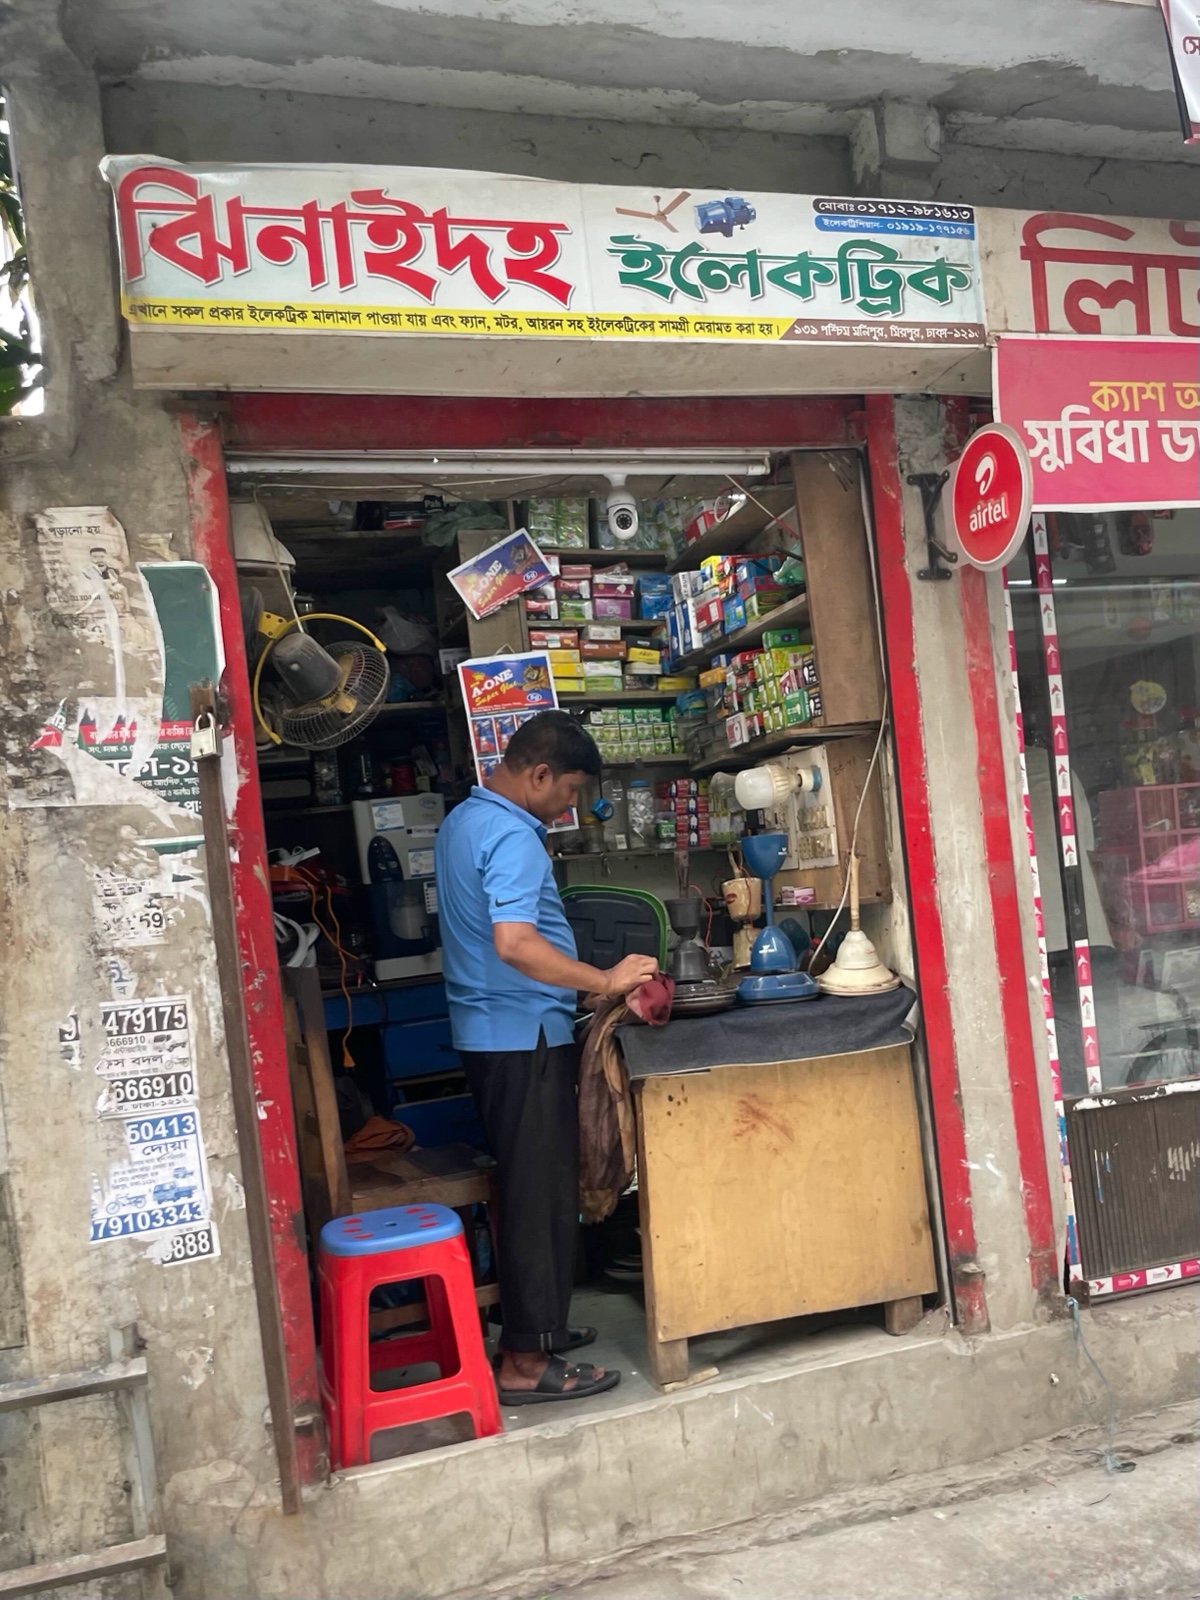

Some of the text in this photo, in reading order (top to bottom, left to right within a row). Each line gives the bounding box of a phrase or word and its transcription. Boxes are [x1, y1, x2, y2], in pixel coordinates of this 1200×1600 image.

[118, 166, 572, 308] ঝিনাইদহ
[605, 234, 973, 318] ইলেকট্রিক
[129, 303, 167, 318] এখানে
[171, 305, 204, 320] সকল
[209, 305, 244, 321] প্রকার
[247, 303, 308, 324] ইলেকট্রিক
[311, 309, 361, 326] মালামাল
[366, 311, 402, 326] পাওয়া
[406, 313, 427, 327] যায়
[431, 314, 457, 329] এবং
[459, 314, 491, 331] ফ্যান,
[494, 313, 523, 332] মটর,
[526, 316, 564, 331] আয়রন
[566, 318, 586, 333] সহ
[659, 316, 689, 334] সামগ্রী
[693, 320, 732, 335] মেরামত
[735, 321, 755, 335] করা
[794, 324, 818, 335] ১৩১
[821, 323, 850, 337] পশ্চিম
[852, 324, 888, 341] মনিপুর,
[889, 325, 924, 342] মিরপুর,
[1089, 381, 1166, 412] ক্যাশ
[1023, 404, 1149, 473] সুবিধা
[969, 496, 1008, 532] airtel
[471, 668, 514, 698] A-ONE
[475, 690, 500, 706] Super
